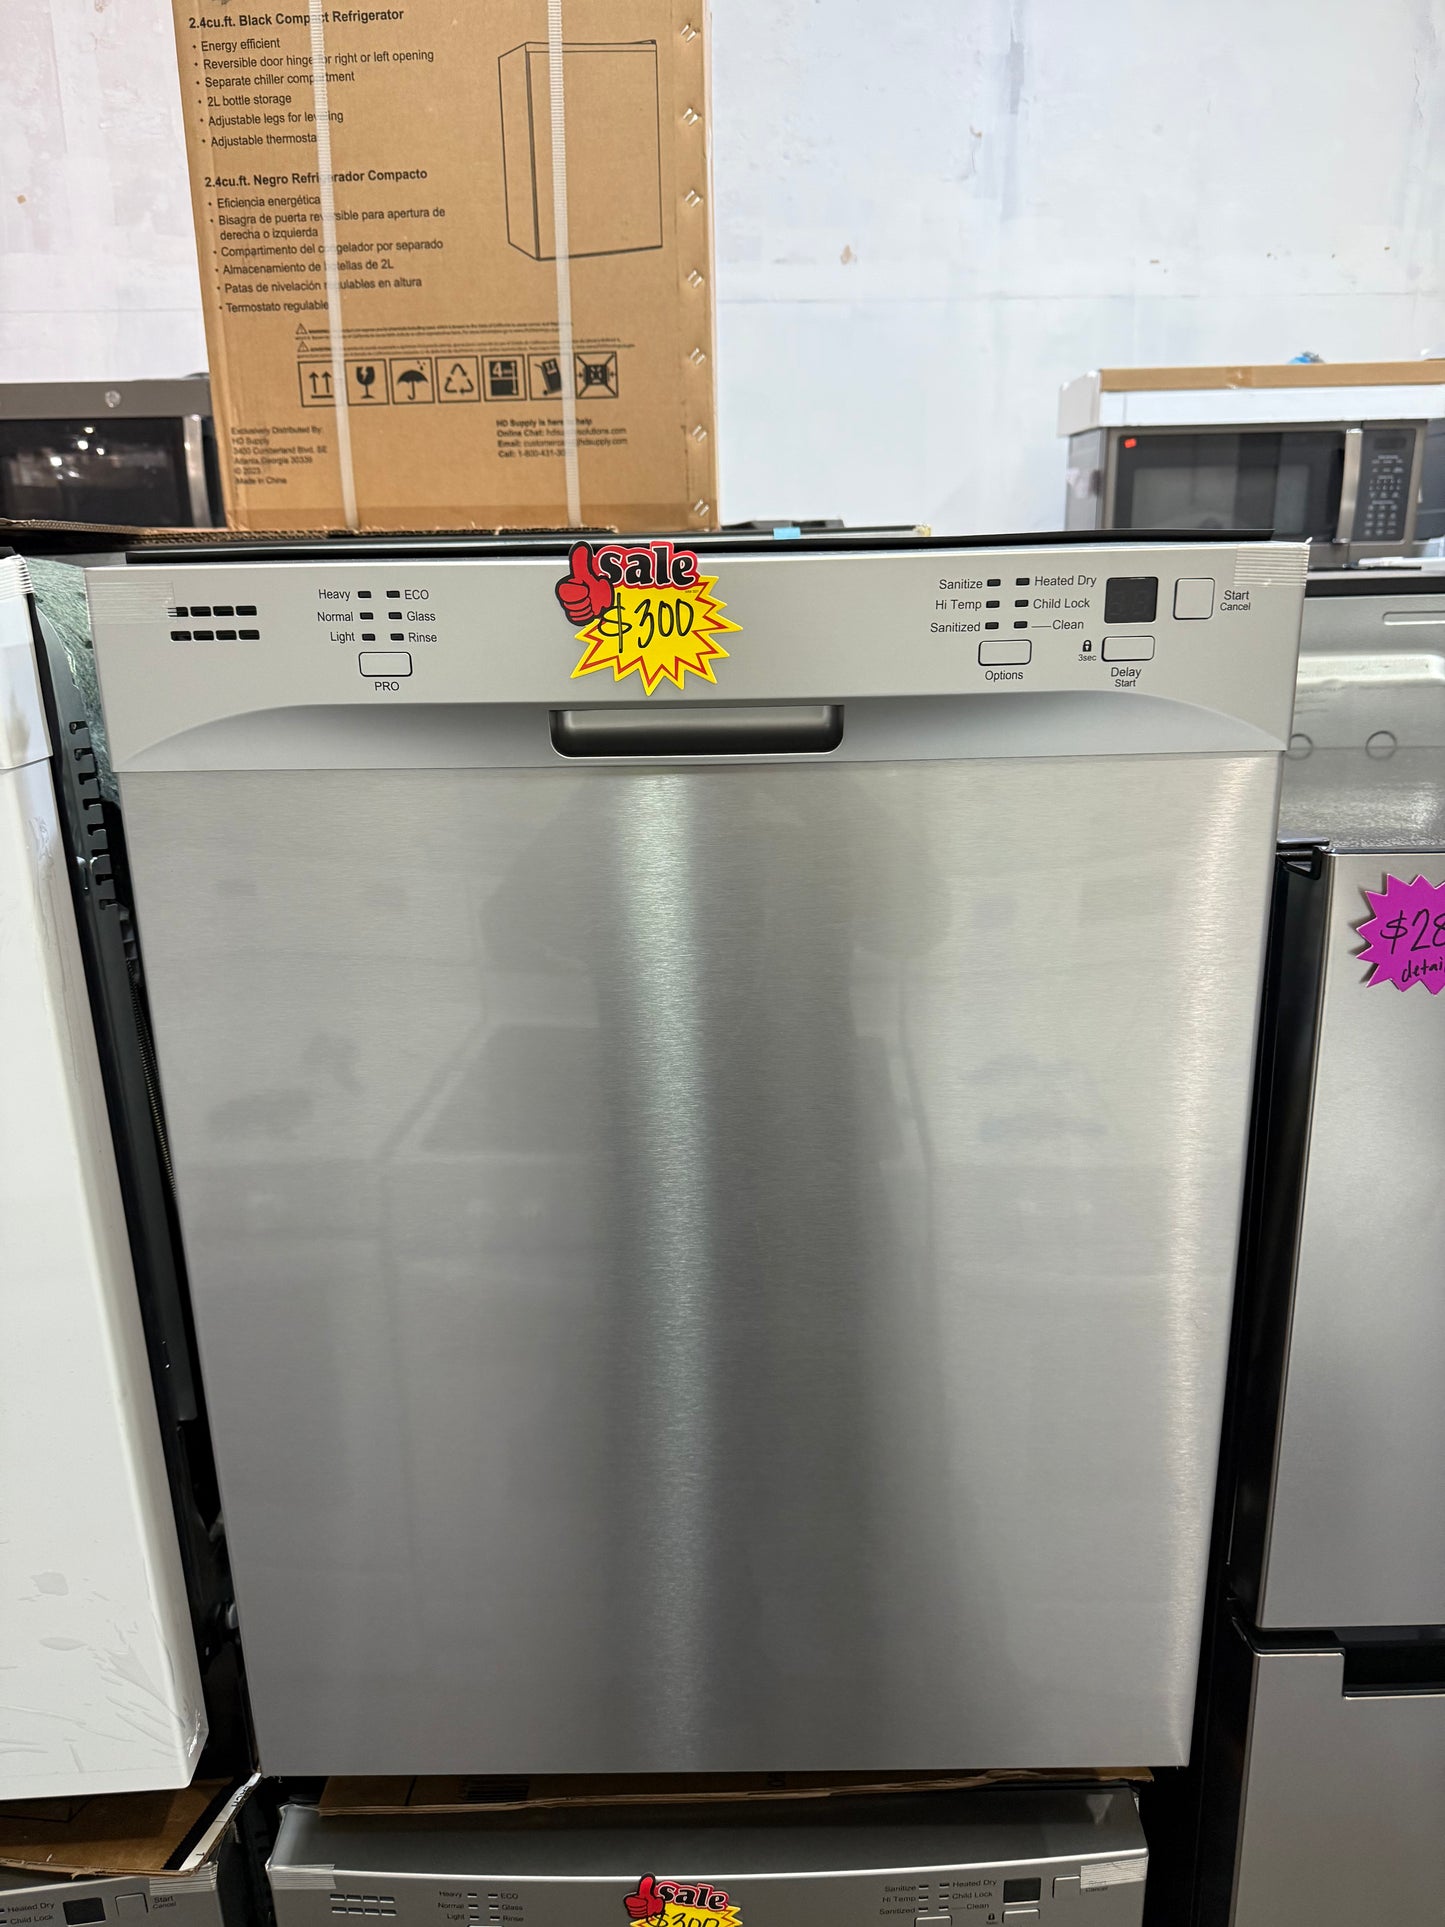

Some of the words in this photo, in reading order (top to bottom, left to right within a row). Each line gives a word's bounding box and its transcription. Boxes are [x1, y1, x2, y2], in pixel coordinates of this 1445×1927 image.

[188, 15, 236, 29] 2.4cu.ft.
[239, 13, 272, 27] Black
[275, 11, 329, 26] Compt
[332, 9, 405, 24] Refrigerator
[201, 40, 237, 53] Energy
[240, 38, 280, 50] efficient
[203, 57, 257, 70] Reversible
[260, 56, 283, 67] door
[334, 52, 358, 66] right
[360, 54, 371, 63] or
[373, 51, 390, 63] left
[392, 50, 434, 64] opening
[204, 76, 251, 90] Separate
[254, 74, 284, 86] chiller
[287, 71, 355, 85] comptment
[207, 95, 221, 107] 2L
[222, 94, 251, 106] bottle
[253, 93, 292, 108] storage
[208, 113, 261, 128] Adjustable
[263, 113, 285, 126] legs
[287, 111, 302, 123] for
[210, 134, 264, 149] Adjustable
[204, 174, 251, 188] 2.4cu.ft.
[253, 173, 289, 188] Negro
[367, 168, 428, 183] Compacto
[217, 196, 265, 209] Eficiencia
[267, 194, 321, 208] energética
[218, 214, 256, 227] Bisagra
[259, 213, 272, 225] de
[274, 213, 307, 225] puerta
[361, 210, 384, 222] para
[387, 207, 430, 221] apertura
[432, 206, 446, 219] de
[219, 229, 261, 241] derecha
[263, 230, 270, 239] o
[272, 227, 319, 241] izquierda
[221, 244, 297, 258] Compartimento
[299, 243, 316, 255] del
[376, 241, 393, 254] por
[396, 238, 443, 251] separado
[222, 262, 306, 275] Almacenamiento
[308, 261, 321, 272] de
[365, 258, 379, 270] de
[381, 259, 394, 269] 2L
[224, 282, 253, 294] Patas
[256, 281, 269, 293] de
[271, 279, 321, 292] nivelación
[378, 279, 391, 289] en
[394, 276, 422, 288] altura
[226, 300, 281, 314] Termostato
[283, 299, 329, 313] regulable
[271, 425, 310, 434] Distributed
[938, 578, 983, 591] Sanitize
[1034, 575, 1074, 587] Heated
[1077, 574, 1097, 588] Dry
[318, 588, 351, 602] Heavy
[404, 588, 430, 600] ECO
[1223, 589, 1250, 601] Start
[935, 599, 947, 611] Hi
[951, 599, 982, 612] Temp
[1032, 598, 1061, 610] Child
[1064, 597, 1090, 609] Lock
[1219, 602, 1251, 612] Cancel
[317, 611, 354, 622] Normal
[406, 610, 436, 622] Glass
[598, 592, 694, 654] $300
[930, 621, 981, 634] Sanitized
[1052, 619, 1084, 631] Clean
[330, 631, 356, 644] Light
[408, 632, 438, 643] Rinse
[1077, 653, 1097, 662] 3sec
[984, 669, 1024, 683] Options
[1110, 666, 1142, 679] Delay
[374, 681, 400, 691] PRO
[1114, 678, 1137, 688] Start
[884, 1884, 917, 1893] Sanitize
[952, 1879, 980, 1888] Heated
[983, 1879, 997, 1887] Dry
[153, 1894, 174, 1904] Start
[438, 1890, 462, 1899] Heavy
[500, 1892, 519, 1900] ECO
[894, 1895, 916, 1903] Temp
[951, 1892, 973, 1900] Child
[974, 1891, 992, 1899] Lock
[7, 1902, 38, 1913] Heated
[40, 1900, 55, 1910] Dry
[152, 1900, 177, 1910] Cancel
[437, 1901, 465, 1910] Normal
[501, 1903, 523, 1911] Glass
[879, 1907, 916, 1916] Sanitized
[966, 1902, 990, 1911] Clean
[10, 1916, 32, 1925] Child
[34, 1913, 55, 1923] Lock
[447, 1913, 465, 1921] Light
